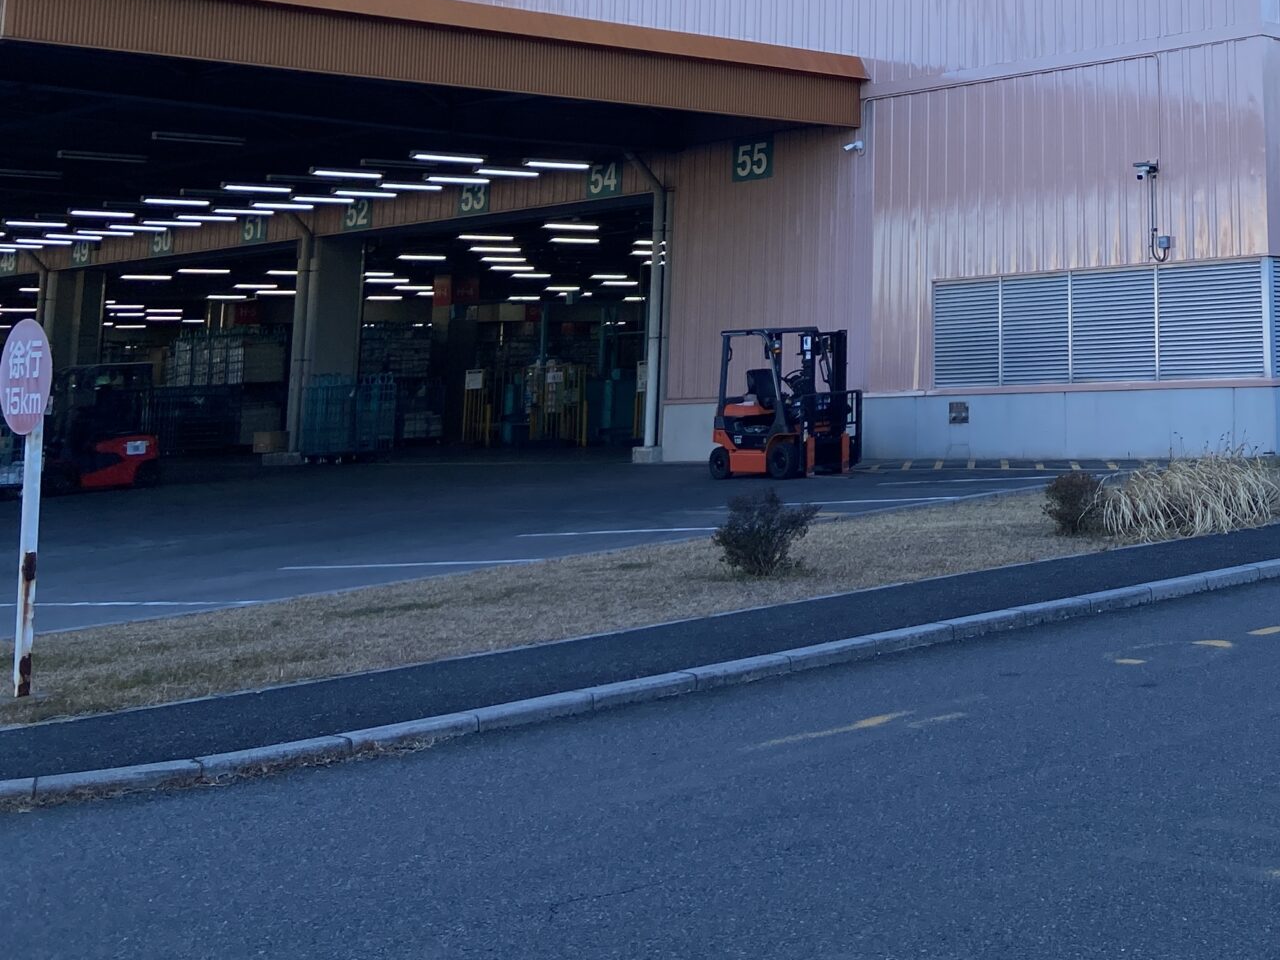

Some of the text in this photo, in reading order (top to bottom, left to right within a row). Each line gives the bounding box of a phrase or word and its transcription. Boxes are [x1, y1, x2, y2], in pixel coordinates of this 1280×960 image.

[737, 142, 768, 177] 55
[590, 162, 618, 194] 54
[461, 183, 486, 212] 53
[346, 199, 369, 227] 52
[244, 216, 262, 241] 51
[73, 241, 90, 262] 49
[8, 340, 43, 379] 徐行
[5, 387, 42, 415] 15km
